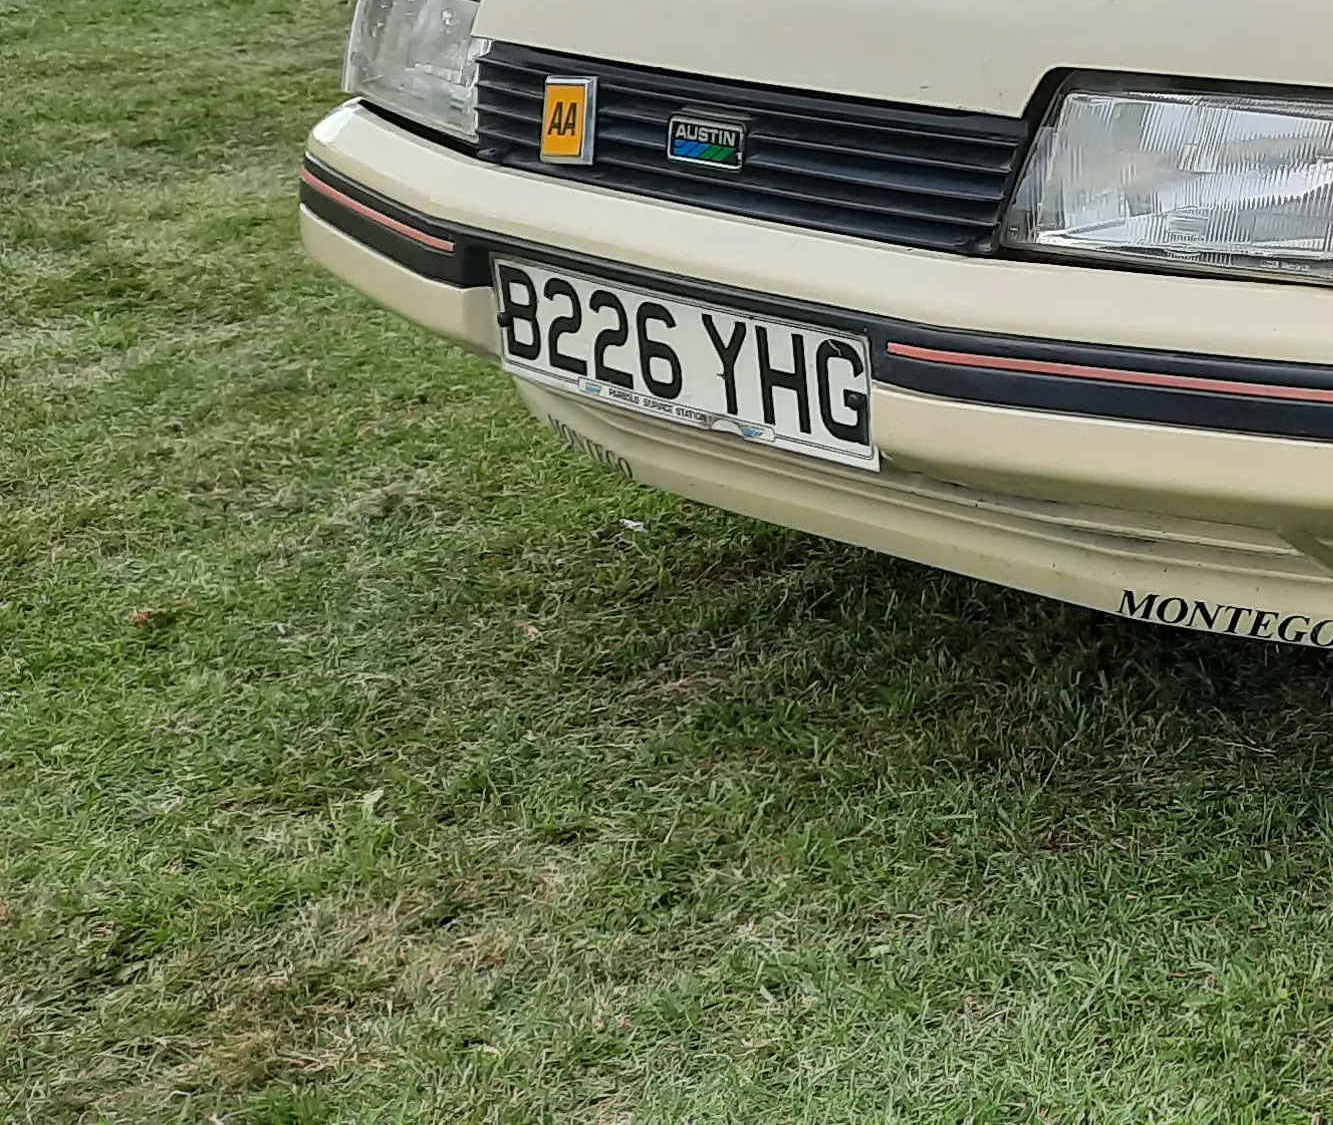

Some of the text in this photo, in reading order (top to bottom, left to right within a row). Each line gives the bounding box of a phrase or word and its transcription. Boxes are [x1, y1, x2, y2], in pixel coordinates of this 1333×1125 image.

[547, 101, 577, 136] AA
[675, 124, 736, 147] AUSTIN
[498, 264, 870, 446] B226 YHG
[675, 407, 708, 422] STATION
